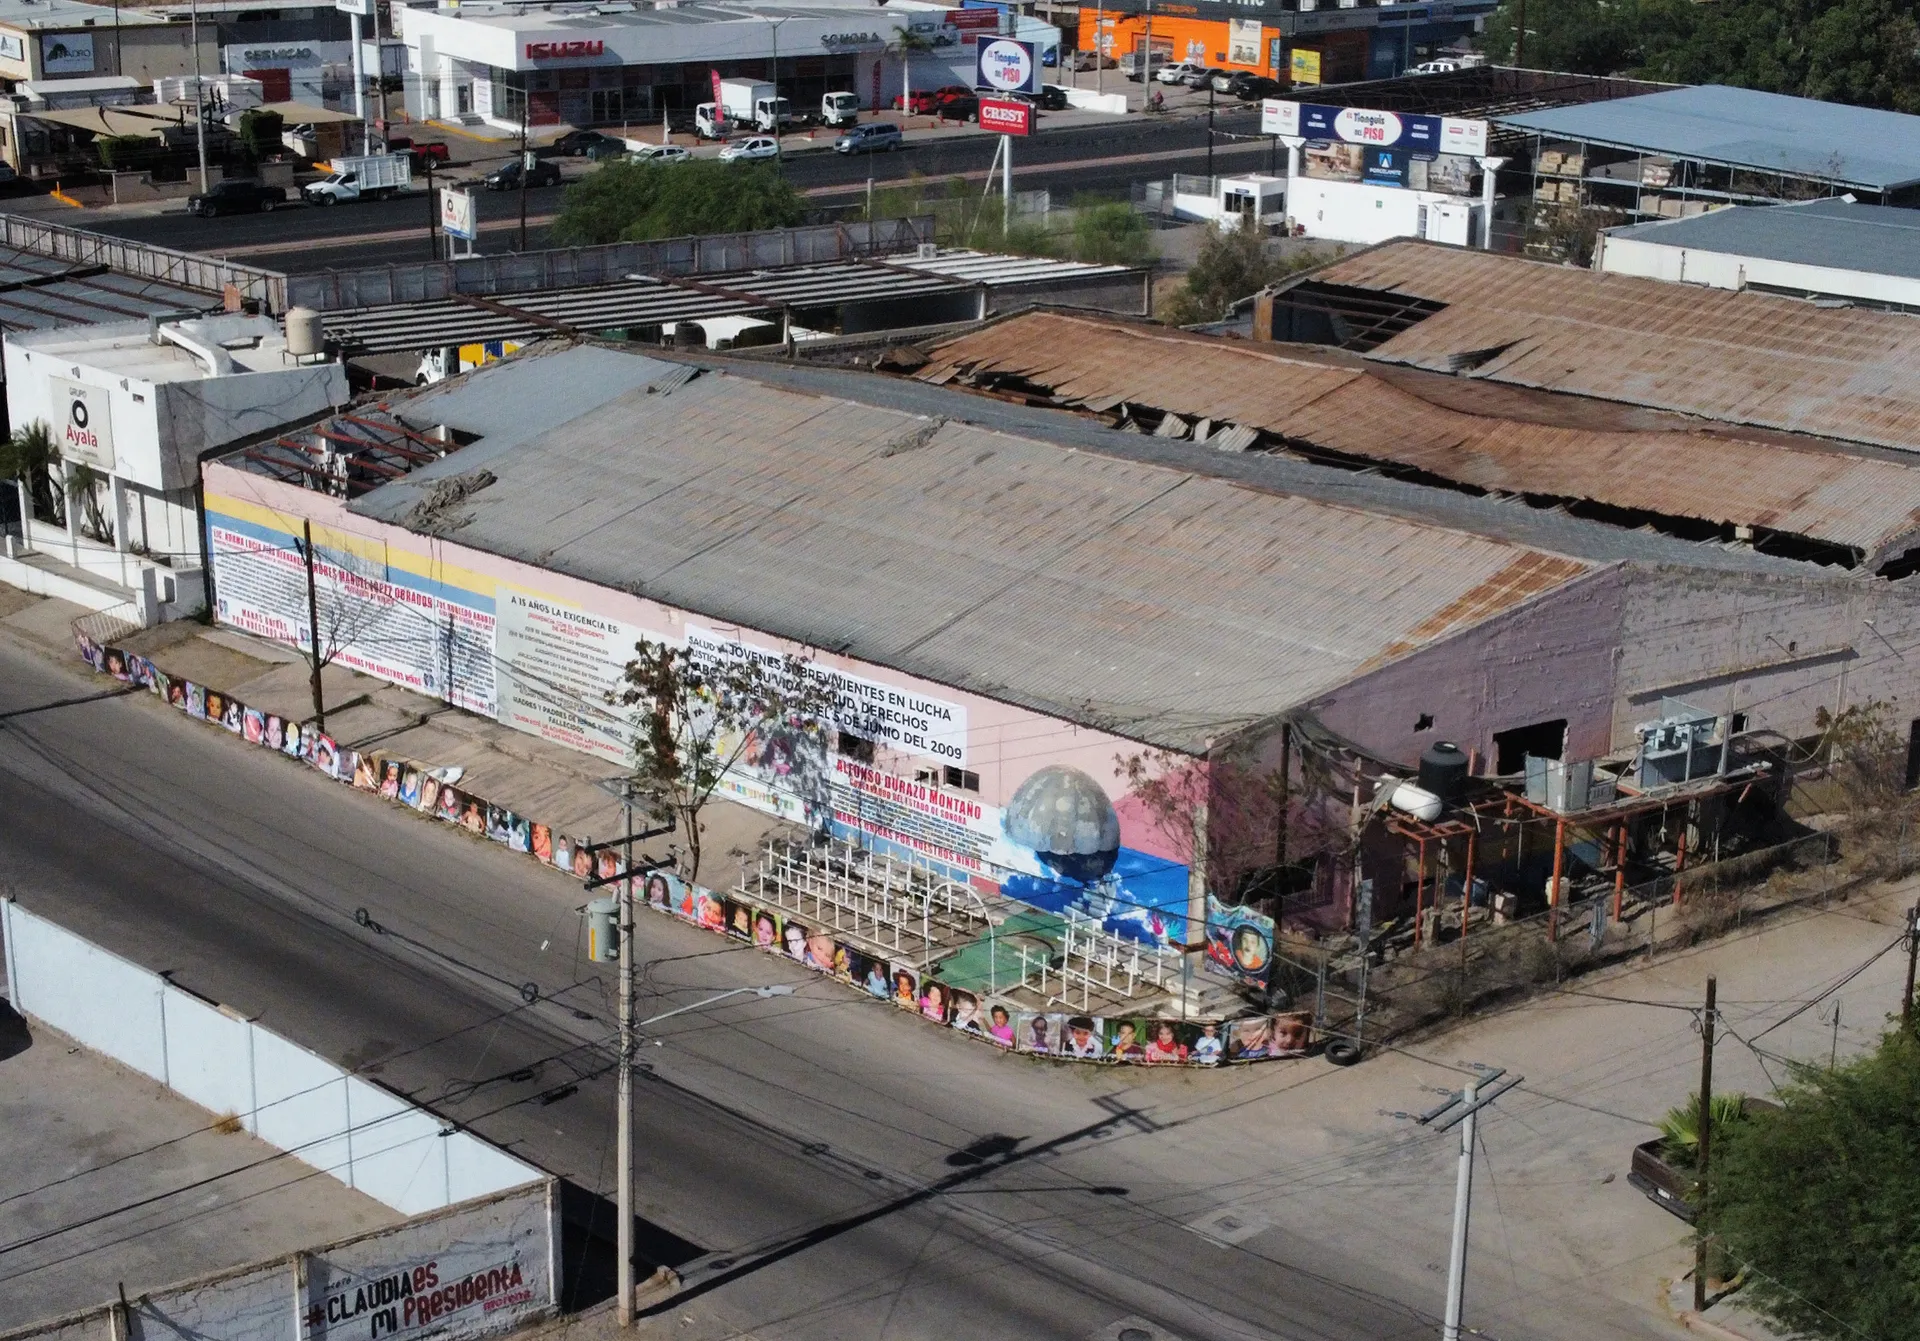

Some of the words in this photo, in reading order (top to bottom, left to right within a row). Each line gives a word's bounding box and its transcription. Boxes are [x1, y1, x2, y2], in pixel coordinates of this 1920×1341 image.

[526, 40, 603, 59] ISUZU
[1003, 67, 1020, 82] PISO
[982, 106, 1024, 123] CREST
[1354, 112, 1385, 126] Tianguis
[1363, 127, 1384, 141] PISO
[69, 387, 87, 398] GRUPO
[66, 425, 98, 448] Ayala
[511, 596, 517, 604] A
[519, 597, 526, 607] 15
[528, 600, 550, 614] AÑOS
[551, 607, 561, 618] LA
[563, 611, 605, 630] EXIGENCIA
[689, 636, 715, 651] SALUD
[345, 654, 364, 668] UNIDAS
[365, 660, 376, 672] POR
[376, 664, 404, 681] NUESTROS
[729, 644, 781, 670] JOVENES
[888, 692, 905, 708] EN
[909, 698, 951, 721] LUCHA
[548, 716, 584, 734] FALLECIDOS
[861, 702, 928, 731] DERECHOS
[817, 704, 830, 720] EL
[833, 711, 840, 722] 5
[844, 714, 860, 729] DE
[863, 719, 900, 741] JUNIO
[904, 732, 927, 749] DEL
[930, 740, 962, 760] 2009
[836, 758, 881, 785] ALFONSO
[884, 775, 926, 801] DURAZO
[929, 787, 981, 820] MONTAÑO
[905, 797, 929, 812] ESTADO
[931, 806, 939, 815] DE
[940, 809, 967, 825] SONORA
[835, 809, 861, 828] MANOS
[864, 820, 892, 840] UNIDAS
[894, 830, 911, 845] POR
[913, 838, 954, 861] NUESTROS
